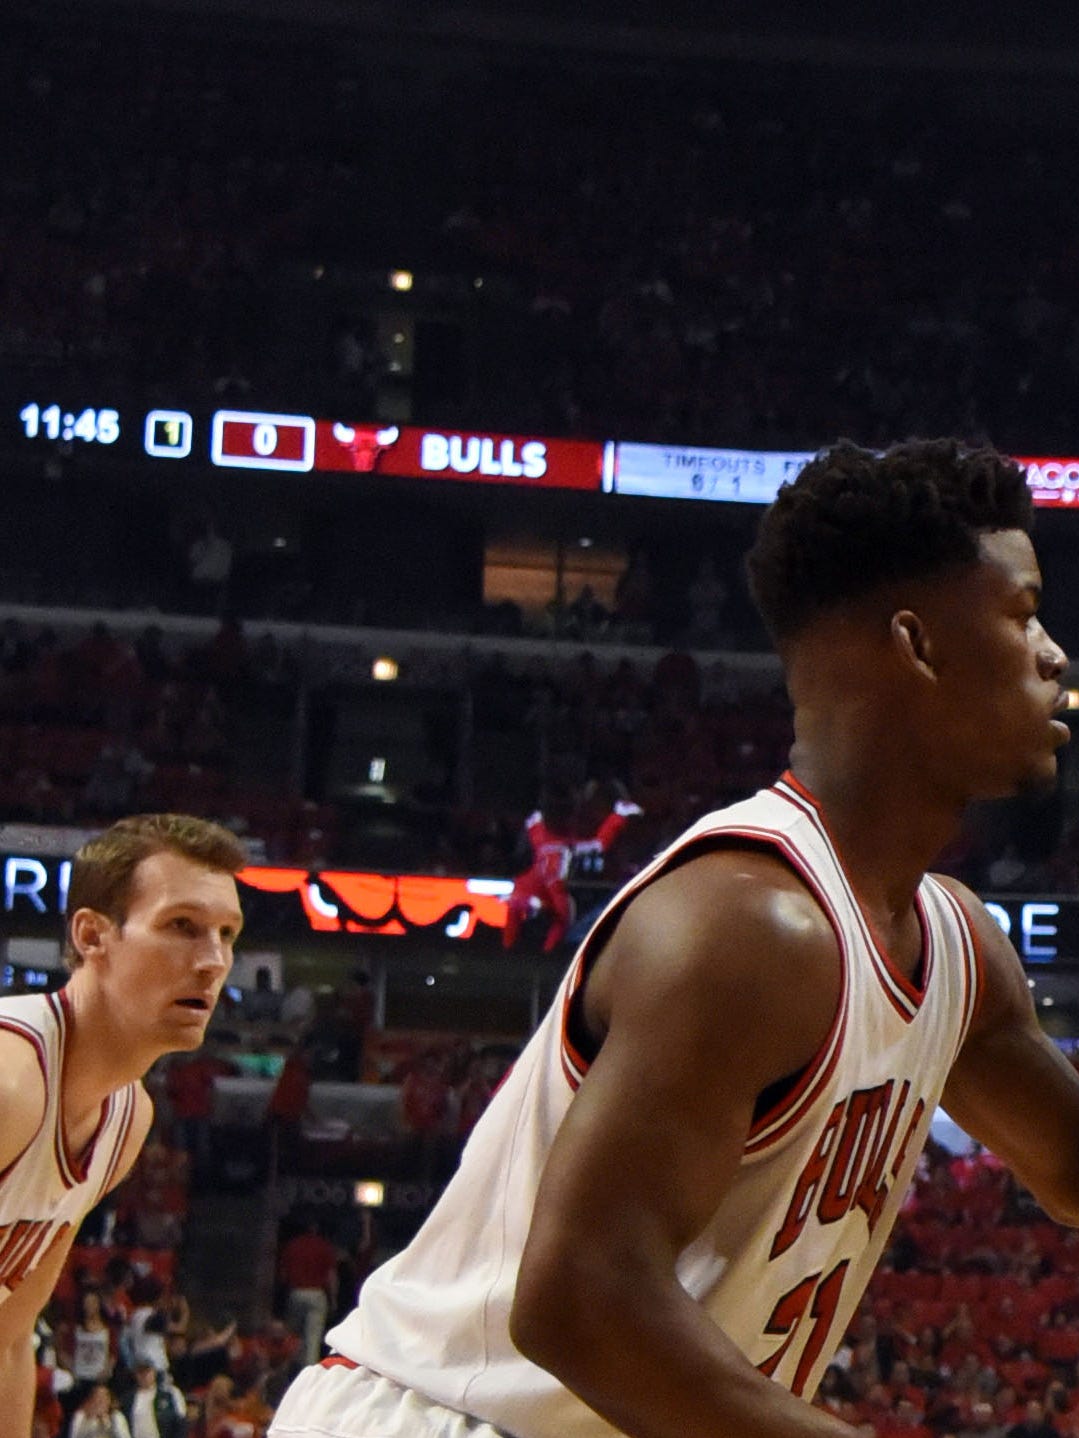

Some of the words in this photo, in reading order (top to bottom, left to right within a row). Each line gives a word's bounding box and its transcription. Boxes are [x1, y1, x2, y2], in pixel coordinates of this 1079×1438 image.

[19, 402, 120, 444] 11:45
[164, 421, 180, 446] 1
[253, 423, 277, 456] 0
[420, 432, 548, 479] BULLS
[664, 453, 767, 475] TIMEOUTS
[757, 1258, 851, 1394] 21
